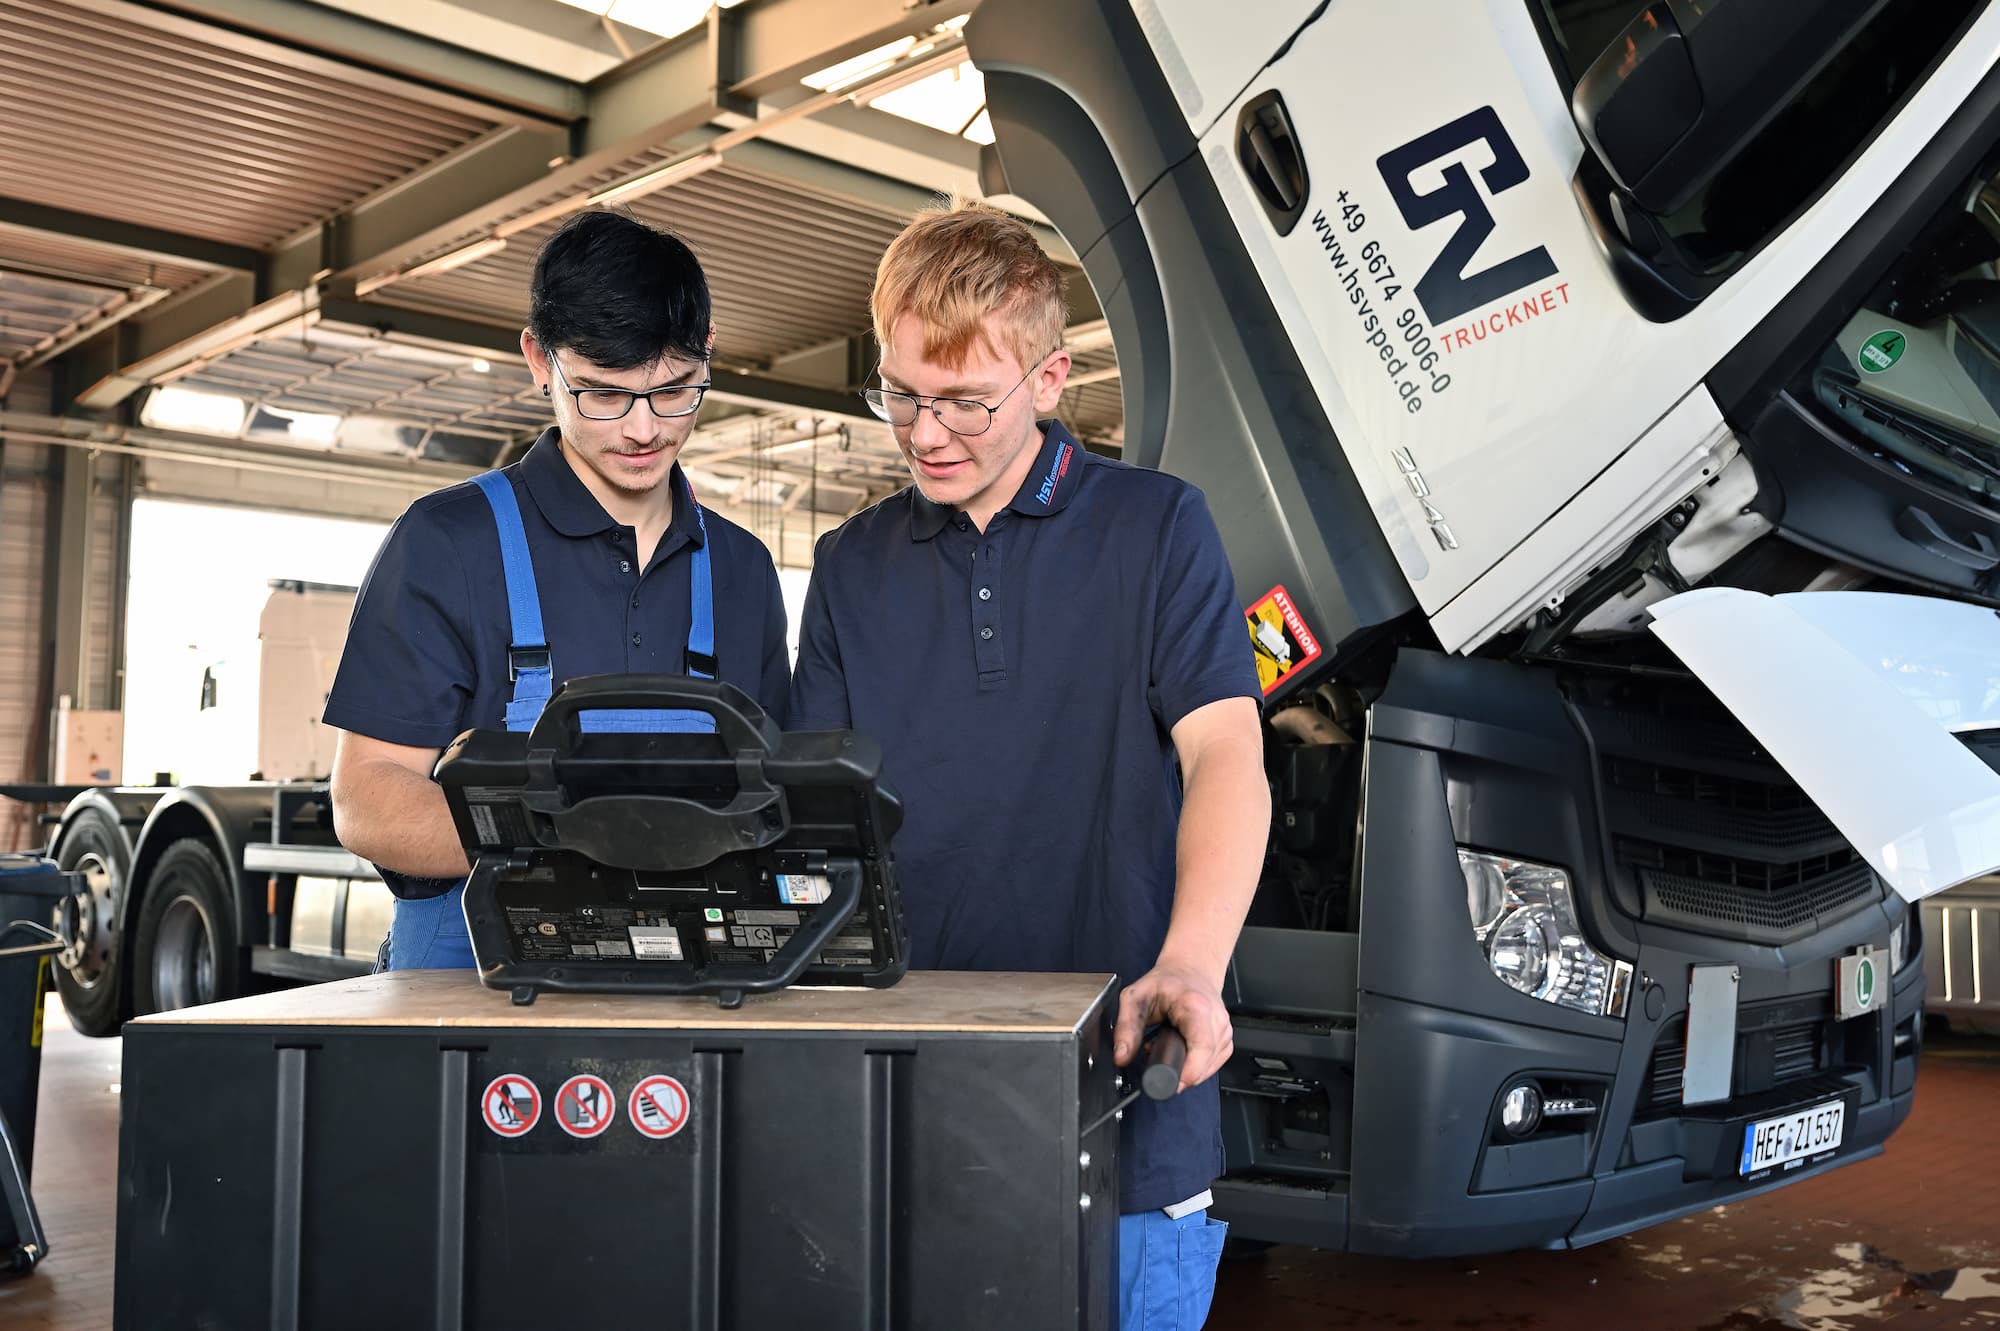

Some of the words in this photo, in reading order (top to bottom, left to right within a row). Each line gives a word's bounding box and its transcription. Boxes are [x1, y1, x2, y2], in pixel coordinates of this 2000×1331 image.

[1311, 208, 1423, 414] www.hsvsped.de
[1336, 189, 1366, 233] +49
[1361, 240, 1403, 301] 6674
[1396, 308, 1452, 394] 9006-0
[1440, 282, 1570, 354] TRUCKNET
[1881, 336, 1900, 353] 4
[1273, 591, 1317, 655] ATTENTION
[1754, 1124, 1784, 1162] HEF
[1815, 1109, 1840, 1145] 537
